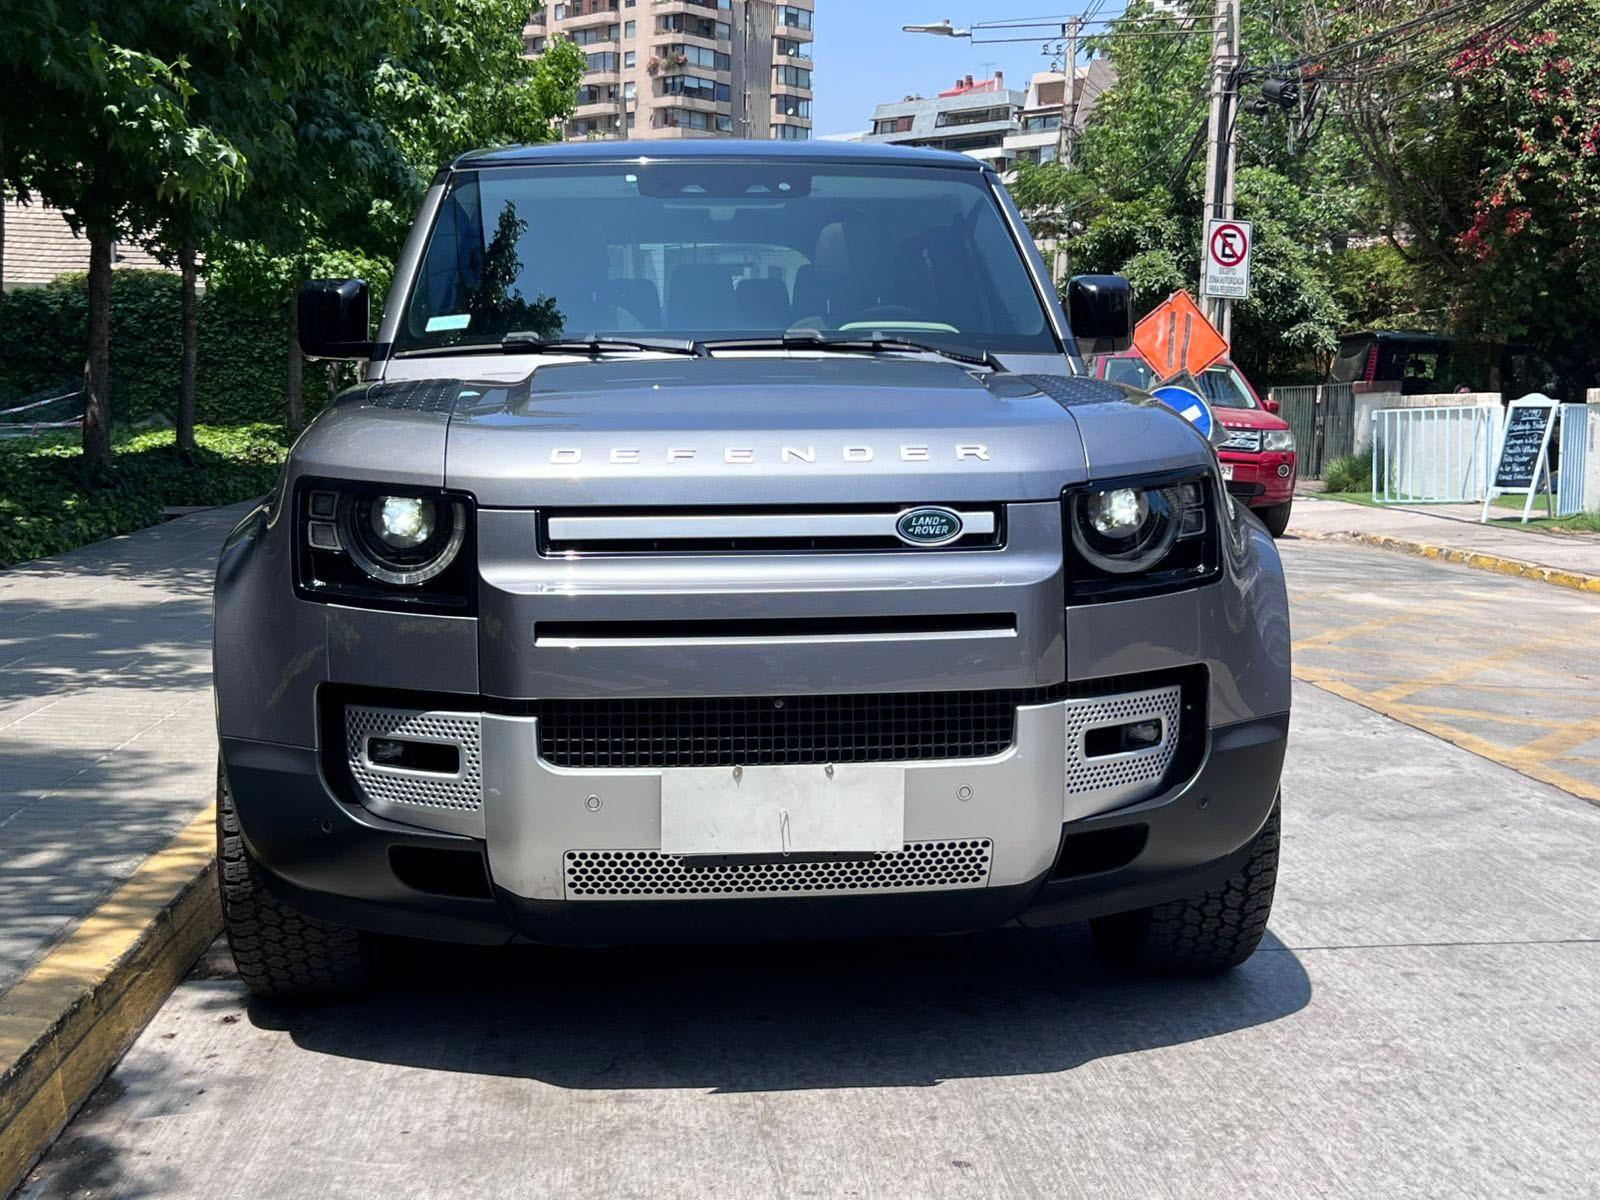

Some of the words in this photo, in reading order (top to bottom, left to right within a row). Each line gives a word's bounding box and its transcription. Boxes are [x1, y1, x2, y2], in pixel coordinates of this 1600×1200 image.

[548, 443, 990, 464] DEFENDER
[911, 516, 940, 526] LAND
[914, 525, 949, 535] ROVER
